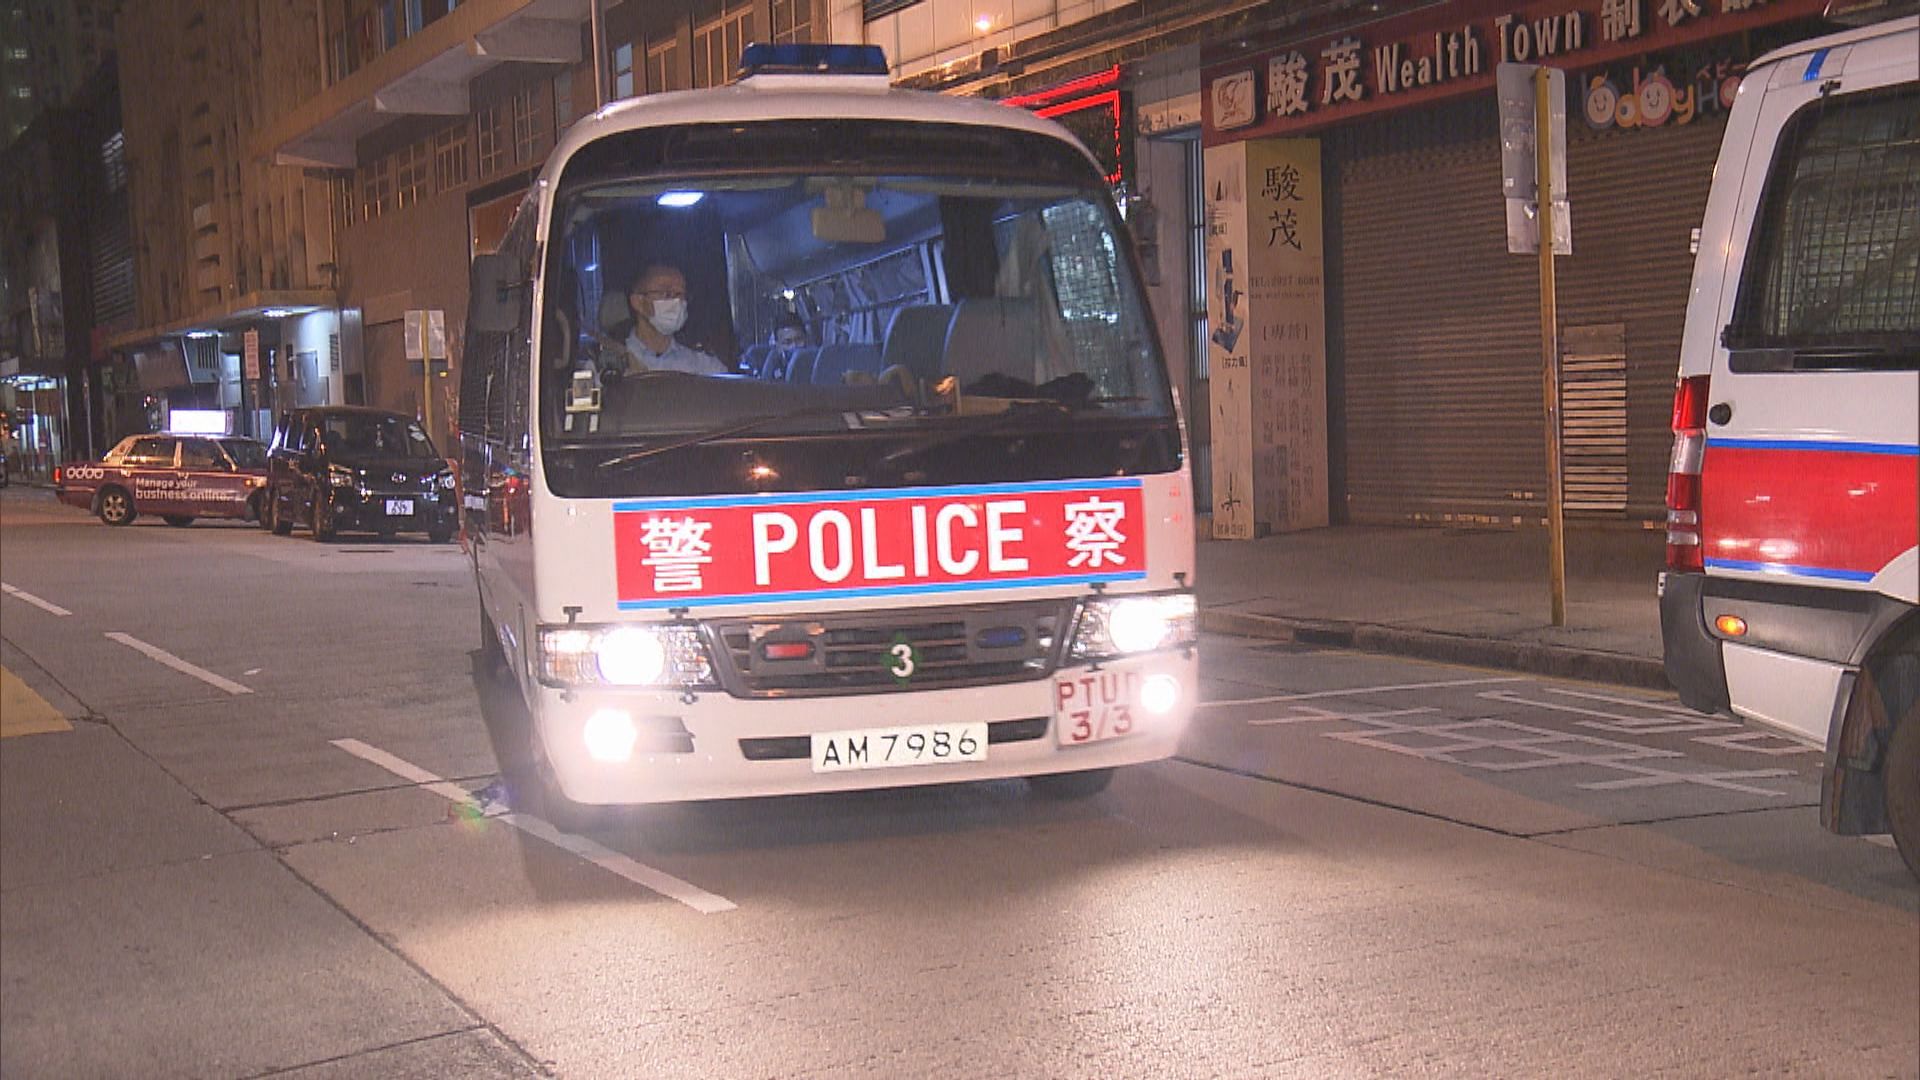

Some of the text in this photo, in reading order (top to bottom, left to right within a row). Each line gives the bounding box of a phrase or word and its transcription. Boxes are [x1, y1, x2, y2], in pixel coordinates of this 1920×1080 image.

[1267, 0, 1771, 116] 駿茂 Wealth Town 制衣
[1261, 164, 1304, 251] 駿茂
[66, 464, 104, 479] odoo
[136, 478, 197, 489] Manage your
[136, 487, 188, 500] business
[640, 496, 1127, 593] 警 POLICE 察
[891, 644, 915, 678] 3
[1071, 704, 1132, 741] 3/3
